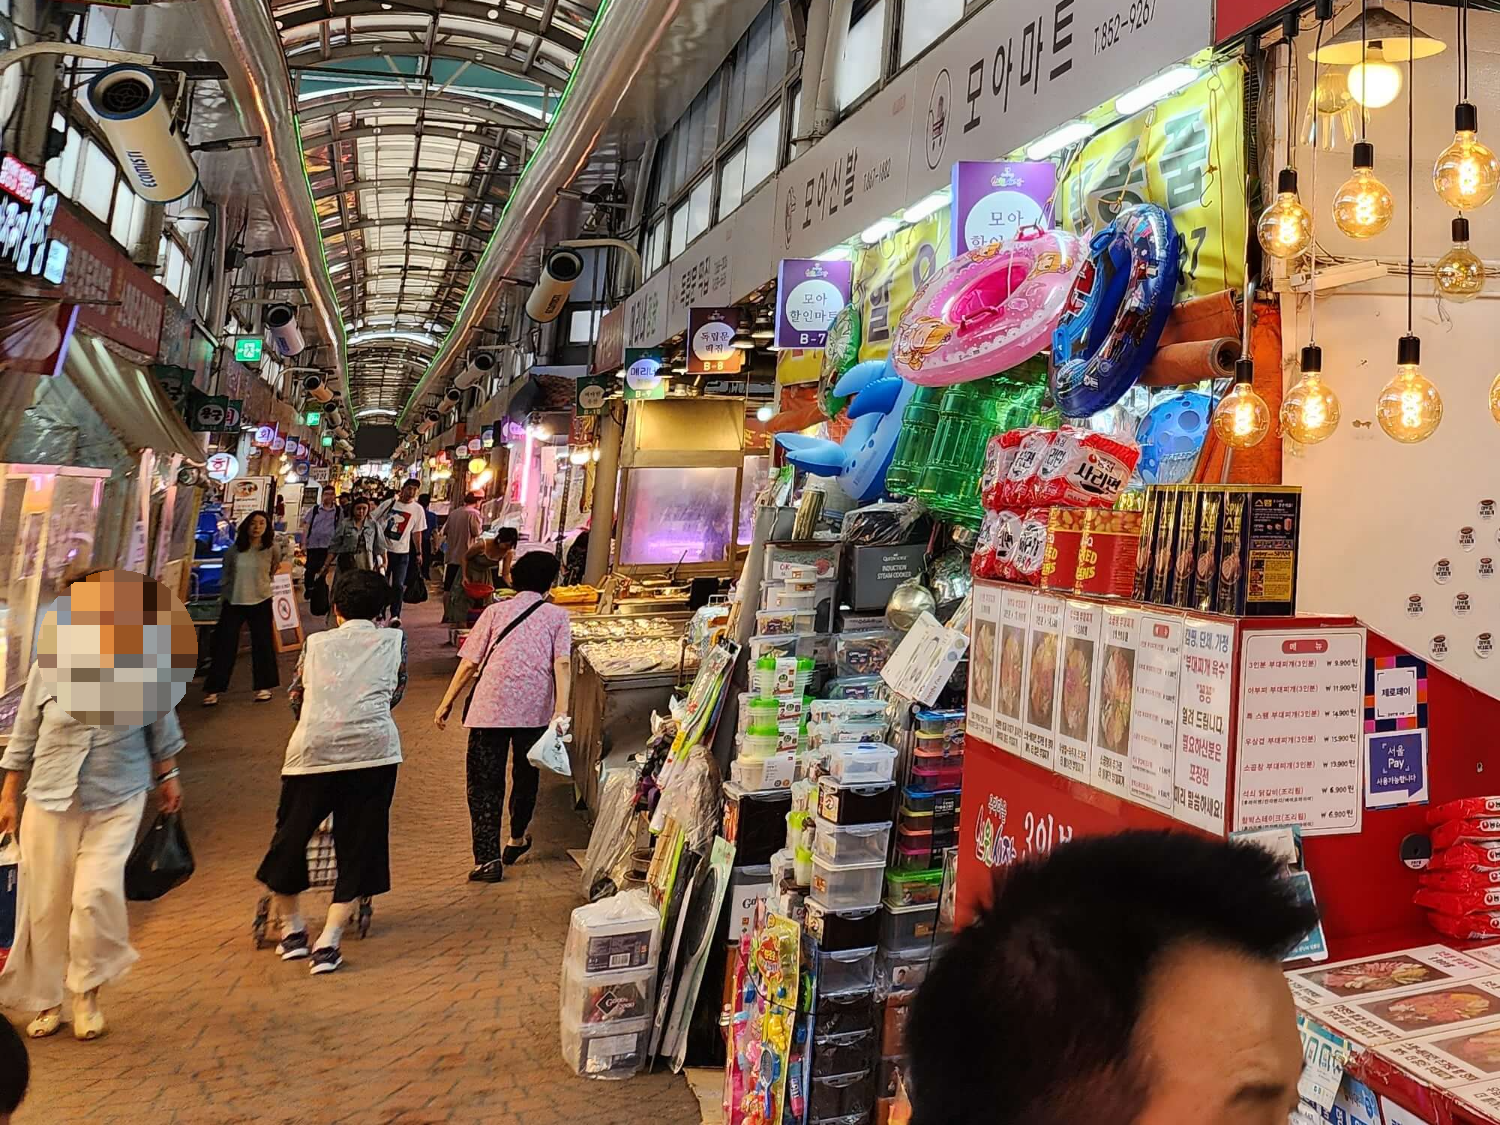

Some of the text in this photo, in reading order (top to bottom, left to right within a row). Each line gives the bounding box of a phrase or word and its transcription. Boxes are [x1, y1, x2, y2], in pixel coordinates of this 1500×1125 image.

[802, 146, 859, 230] 모아신발
[988, 209, 1024, 227] 모아
[802, 292, 828, 305] 모아
[790, 309, 838, 324] 할인마트
[700, 331, 730, 343] 독립문
[800, 333, 826, 345] B-7
[703, 361, 724, 372] B-8
[1074, 461, 1122, 495] 사리면
[1387, 744, 1405, 757] 서울
[1388, 758, 1405, 770] Pay
[1376, 773, 1417, 786] 사용가능합니다
